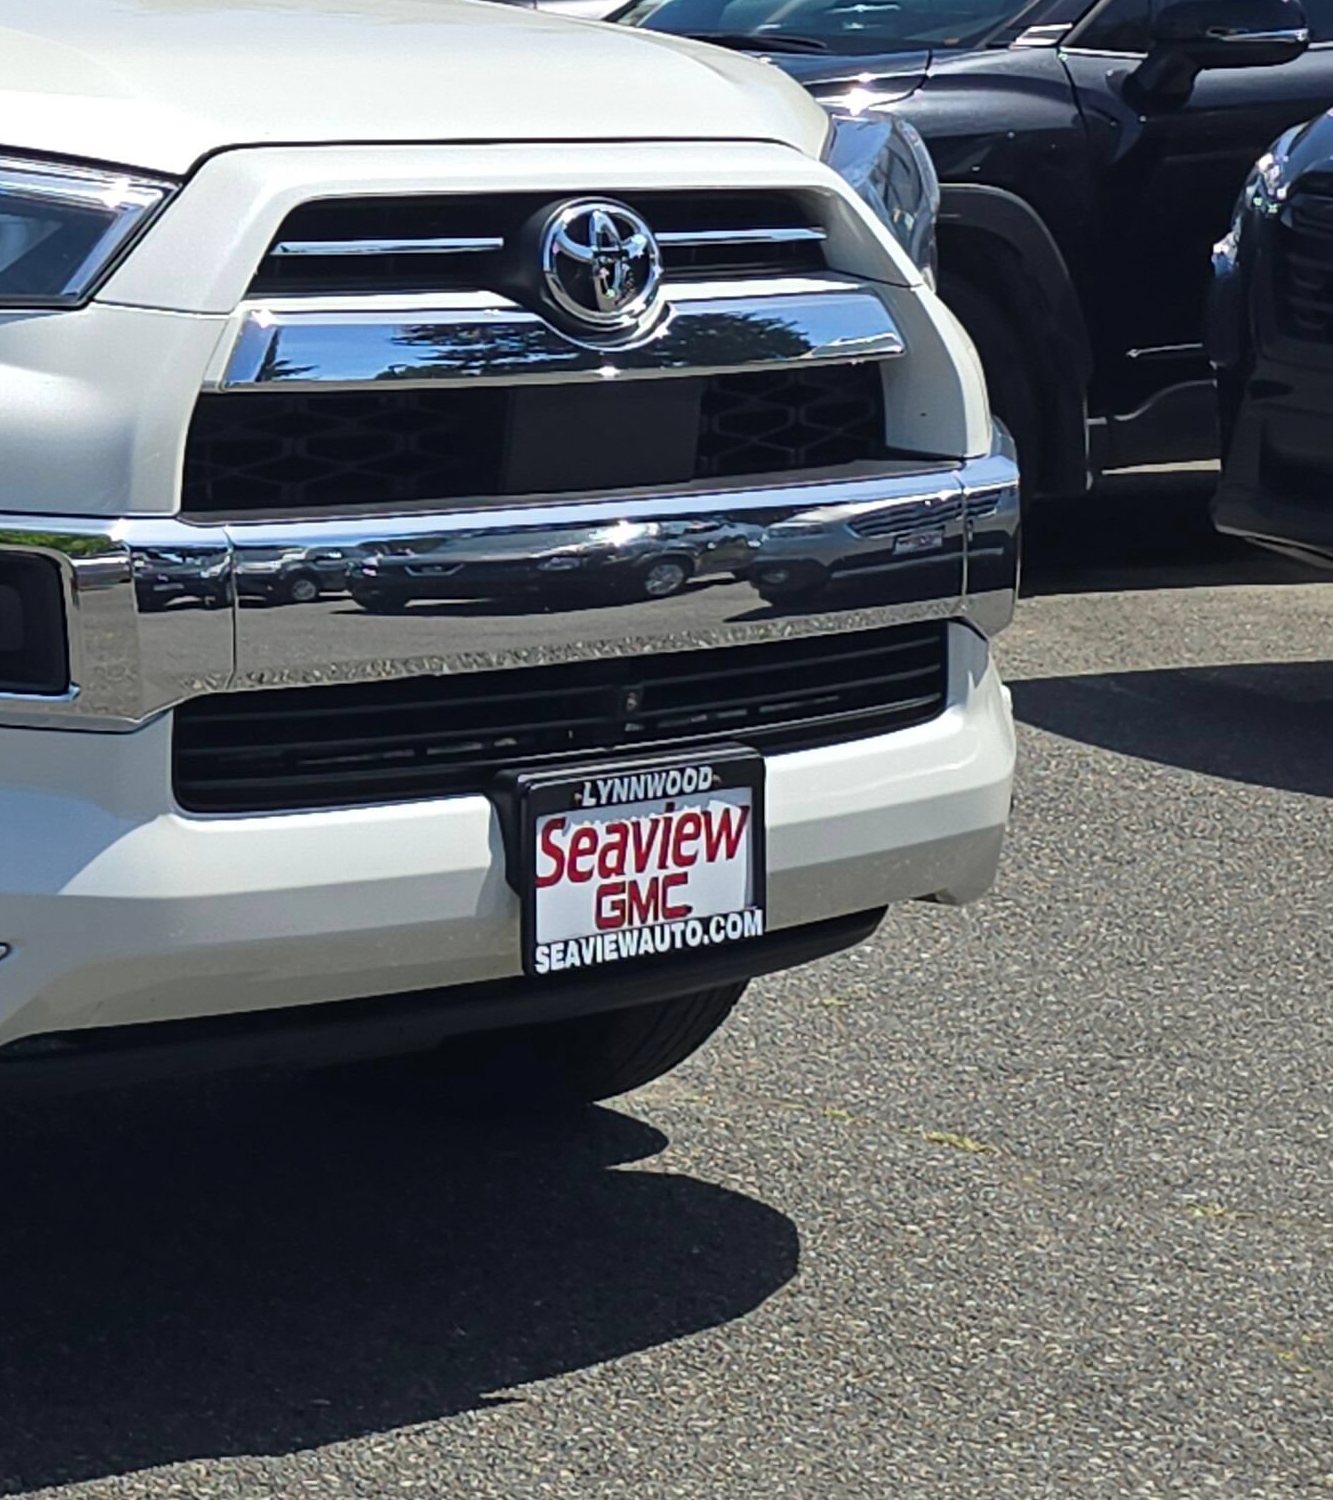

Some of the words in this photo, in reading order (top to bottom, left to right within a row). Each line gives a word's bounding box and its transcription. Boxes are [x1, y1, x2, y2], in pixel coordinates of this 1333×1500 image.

[581, 766, 713, 807] LYNNWOOD
[535, 802, 750, 888] Seaview
[595, 872, 693, 930] GMC
[534, 910, 763, 975] SEAVIEWAUTO.COM
